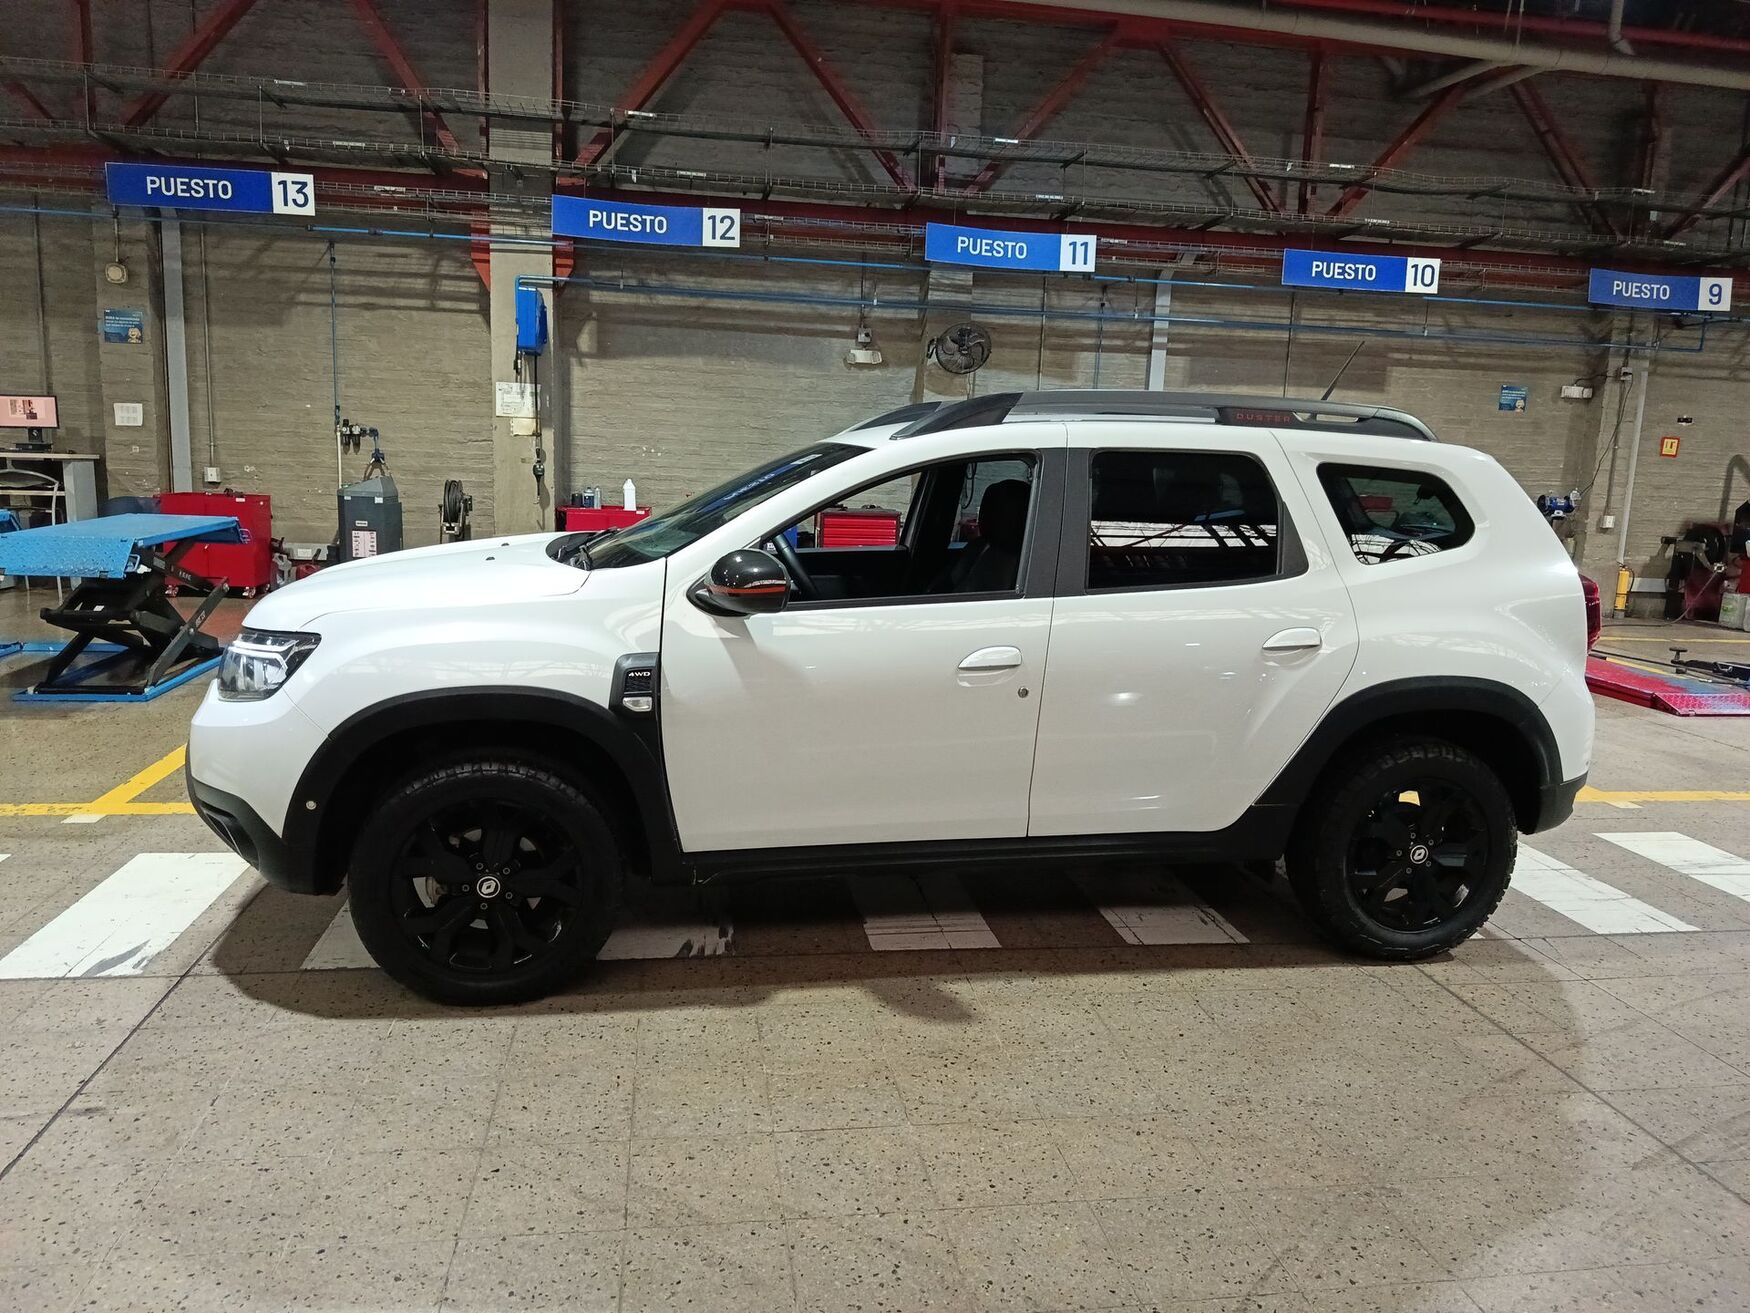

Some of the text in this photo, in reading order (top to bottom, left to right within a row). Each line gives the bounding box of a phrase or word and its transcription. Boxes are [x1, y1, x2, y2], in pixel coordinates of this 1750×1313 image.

[146, 176, 310, 208] PUESTO 13
[589, 210, 736, 240] PUESTO 12
[957, 236, 1089, 265] PUESTO 11
[1311, 261, 1436, 287] PUESTO 10
[1612, 280, 1723, 305] PUESTO 9
[1236, 413, 1291, 424] DUSTER
